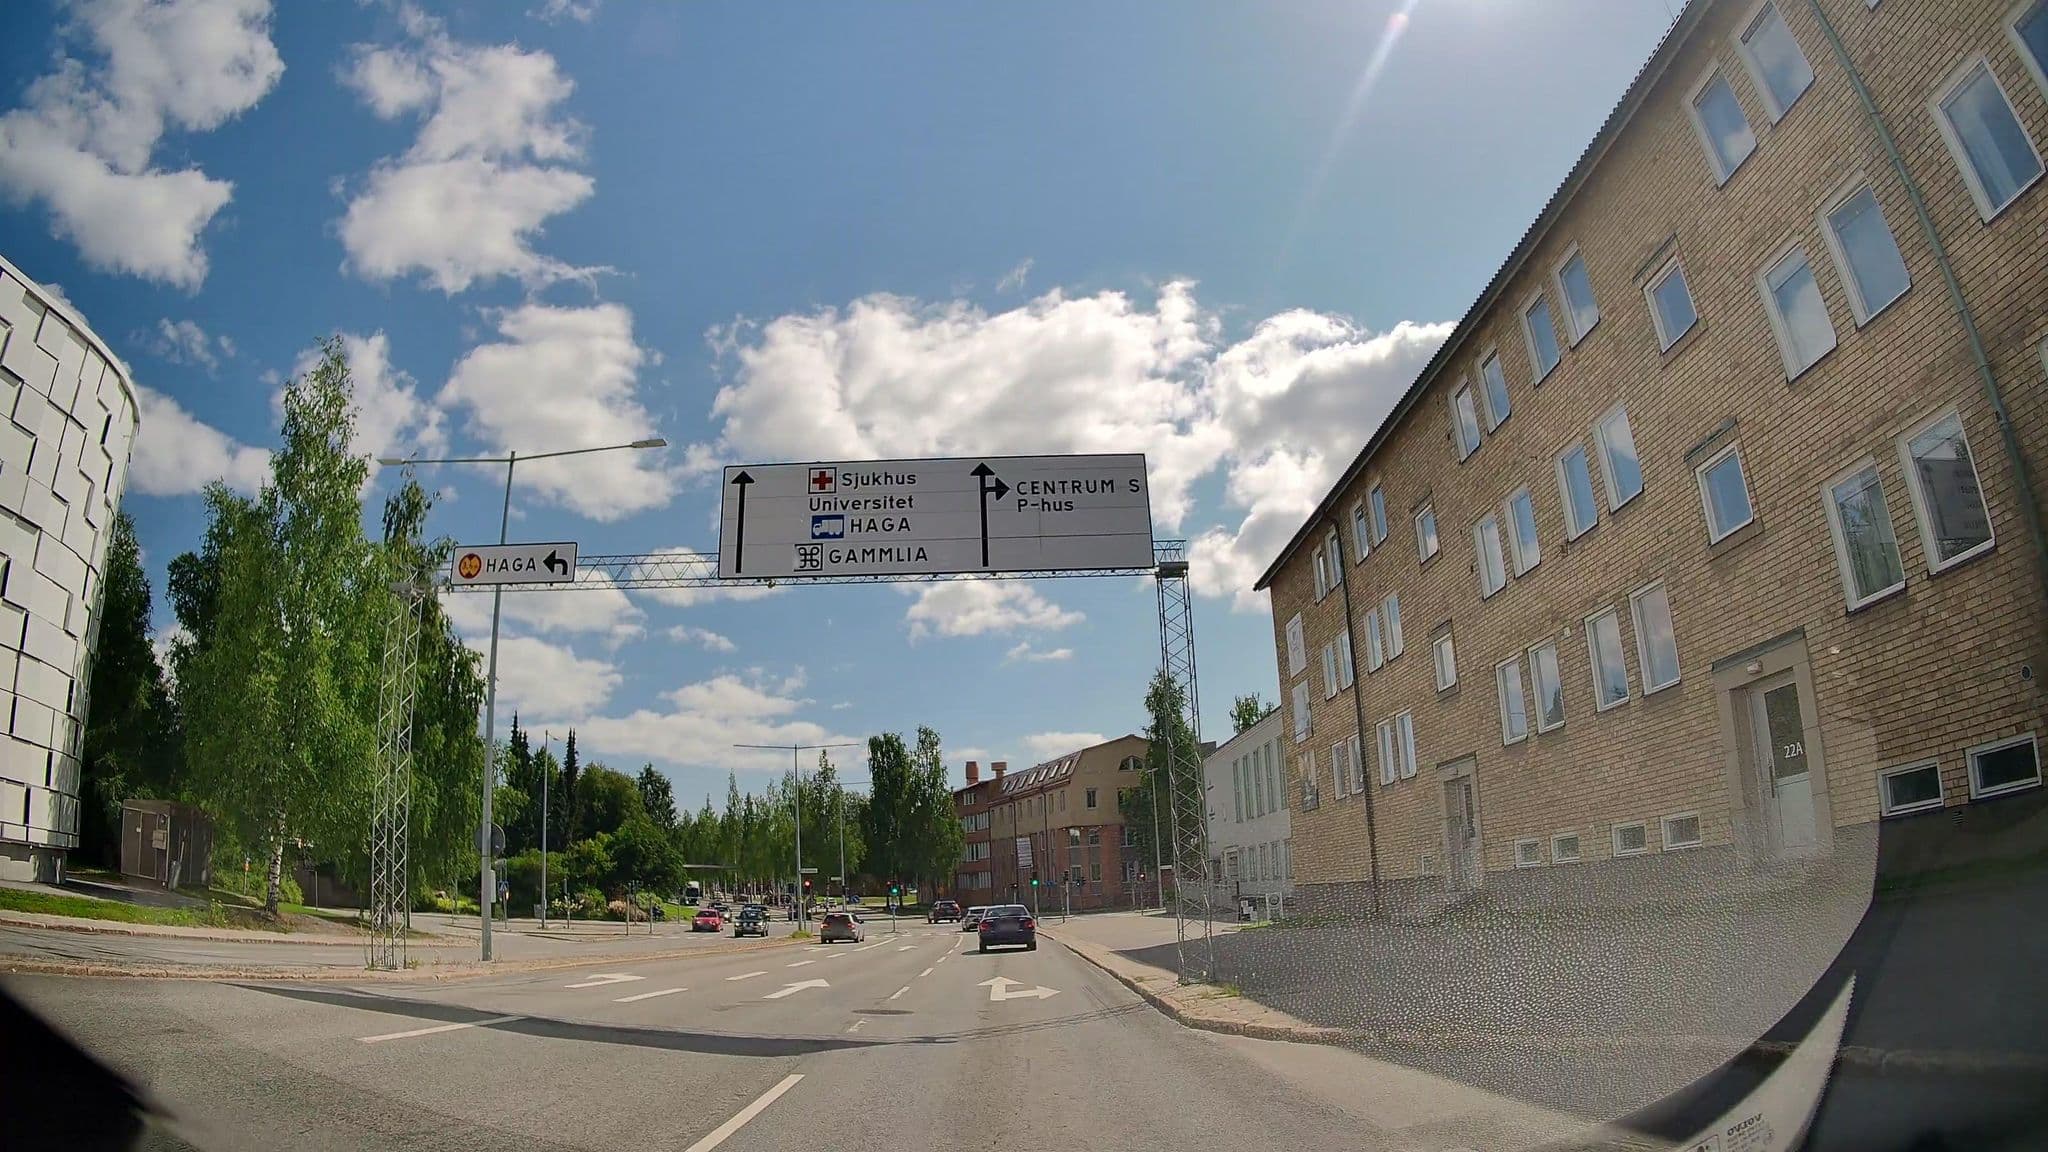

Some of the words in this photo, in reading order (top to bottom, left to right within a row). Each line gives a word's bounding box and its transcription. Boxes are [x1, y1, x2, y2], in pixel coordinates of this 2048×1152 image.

[841, 472, 916, 489] Sjukhus
[1017, 480, 1115, 495] CENTRUM
[1129, 479, 1140, 493] S
[809, 495, 914, 511] Universitet
[1018, 498, 1074, 512] P-hus
[850, 518, 911, 533] HAGA
[829, 547, 928, 564] GAMMLIA
[486, 557, 536, 572] HAGA
[1784, 742, 1803, 758] 22A
